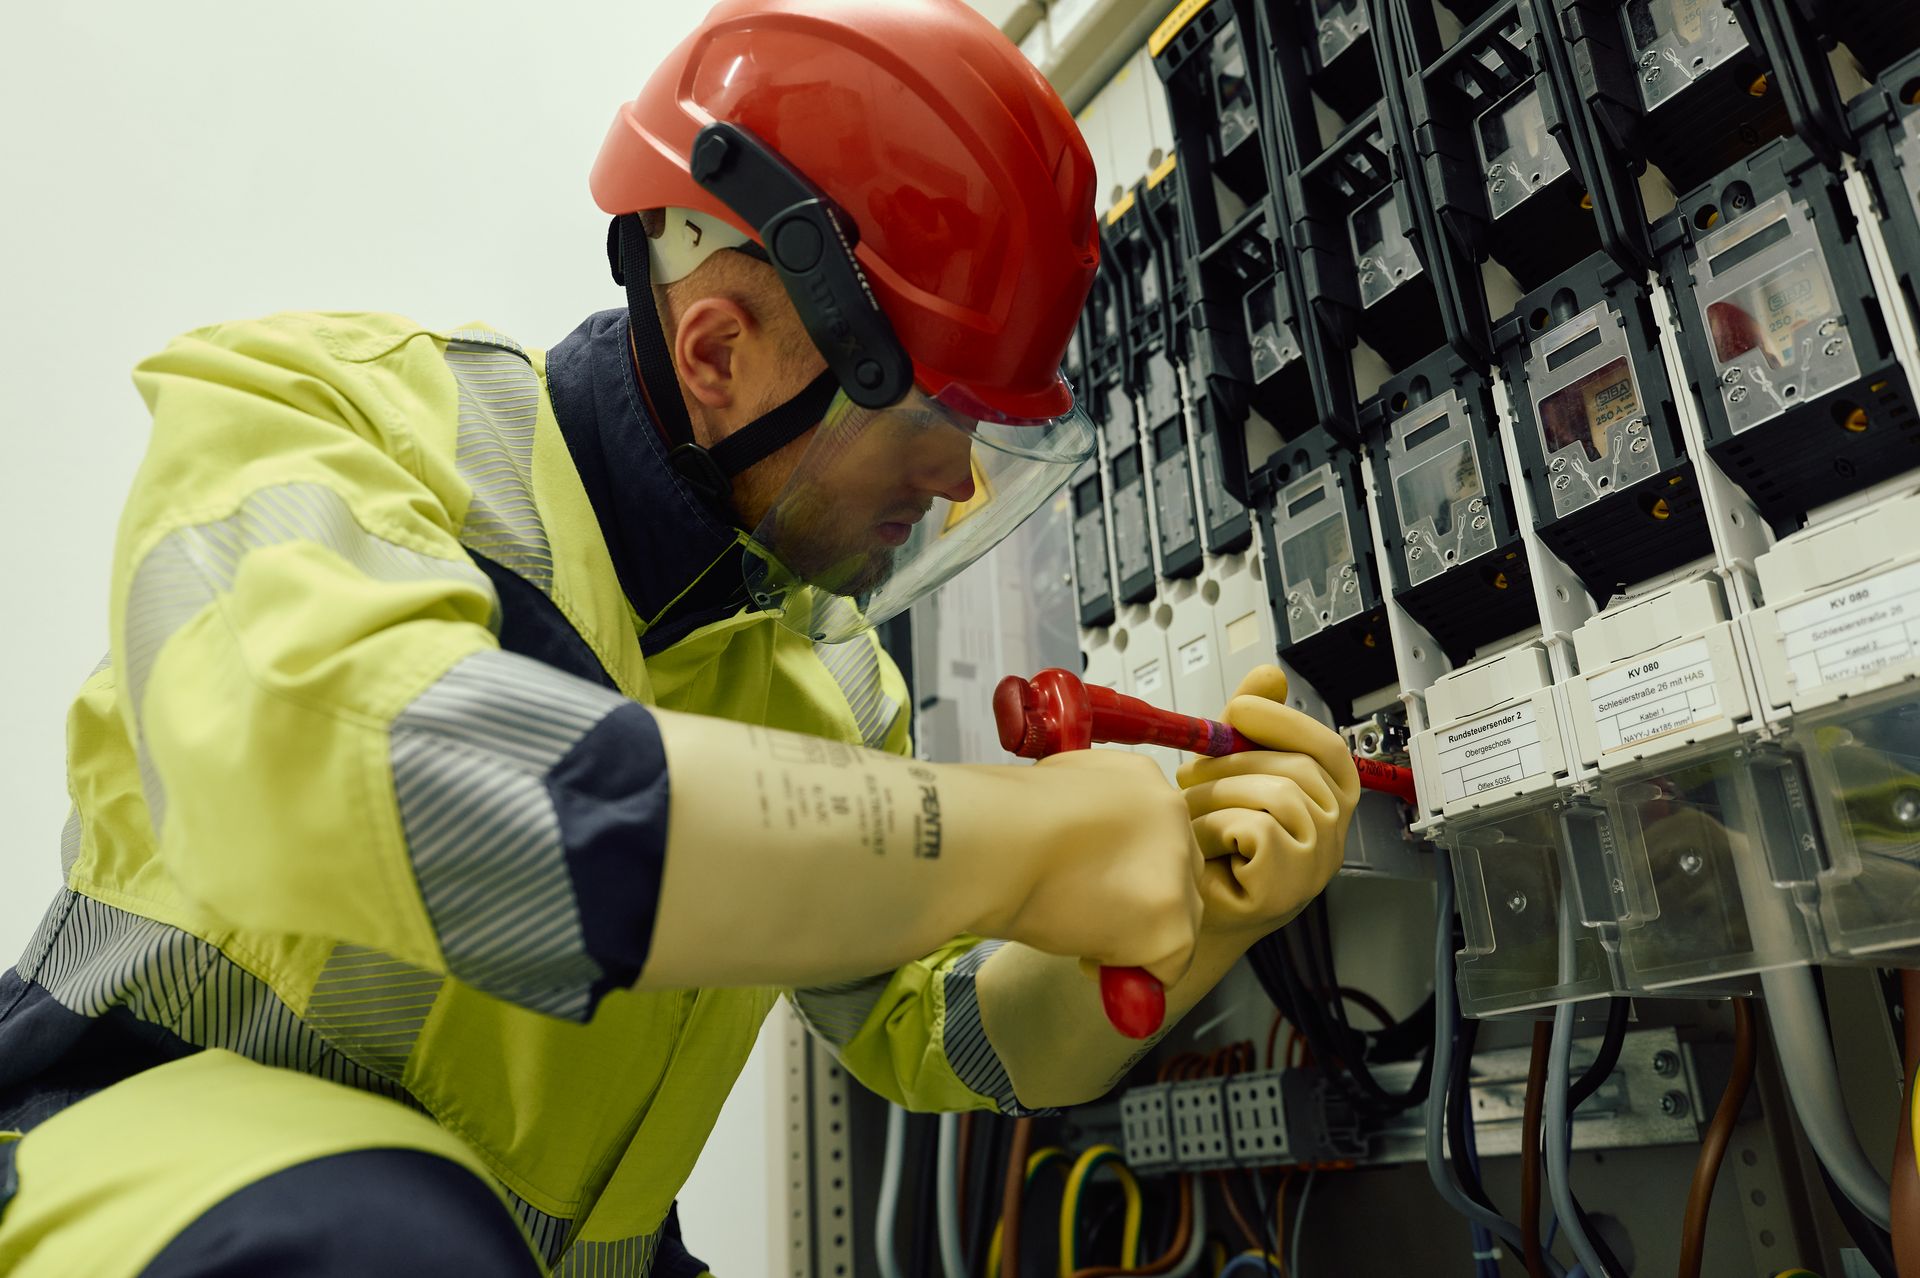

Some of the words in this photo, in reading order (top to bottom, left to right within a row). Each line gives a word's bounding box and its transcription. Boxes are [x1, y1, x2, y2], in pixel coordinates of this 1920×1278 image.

[1769, 315, 1792, 333] 250
[1598, 383, 1629, 404] SIBA
[1596, 410, 1614, 426] 250
[1615, 405, 1623, 415] A
[1830, 598, 1846, 610] KV
[1627, 667, 1641, 680] KV
[1643, 661, 1660, 674] 080
[1598, 687, 1656, 713] Schlesierstraße
[1657, 681, 1669, 693] 26
[1669, 677, 1683, 688] mit
[1684, 669, 1705, 683] HAS
[1639, 709, 1661, 721] Kabel
[1660, 707, 1665, 716] 1
[1448, 714, 1515, 743] Rundsteuersender
[1515, 711, 1522, 721] 2
[1623, 729, 1651, 744] NAYY-J
[1651, 722, 1673, 735] 4x185
[1464, 737, 1512, 758] Obergeschoss
[1477, 781, 1494, 791] Ölflex
